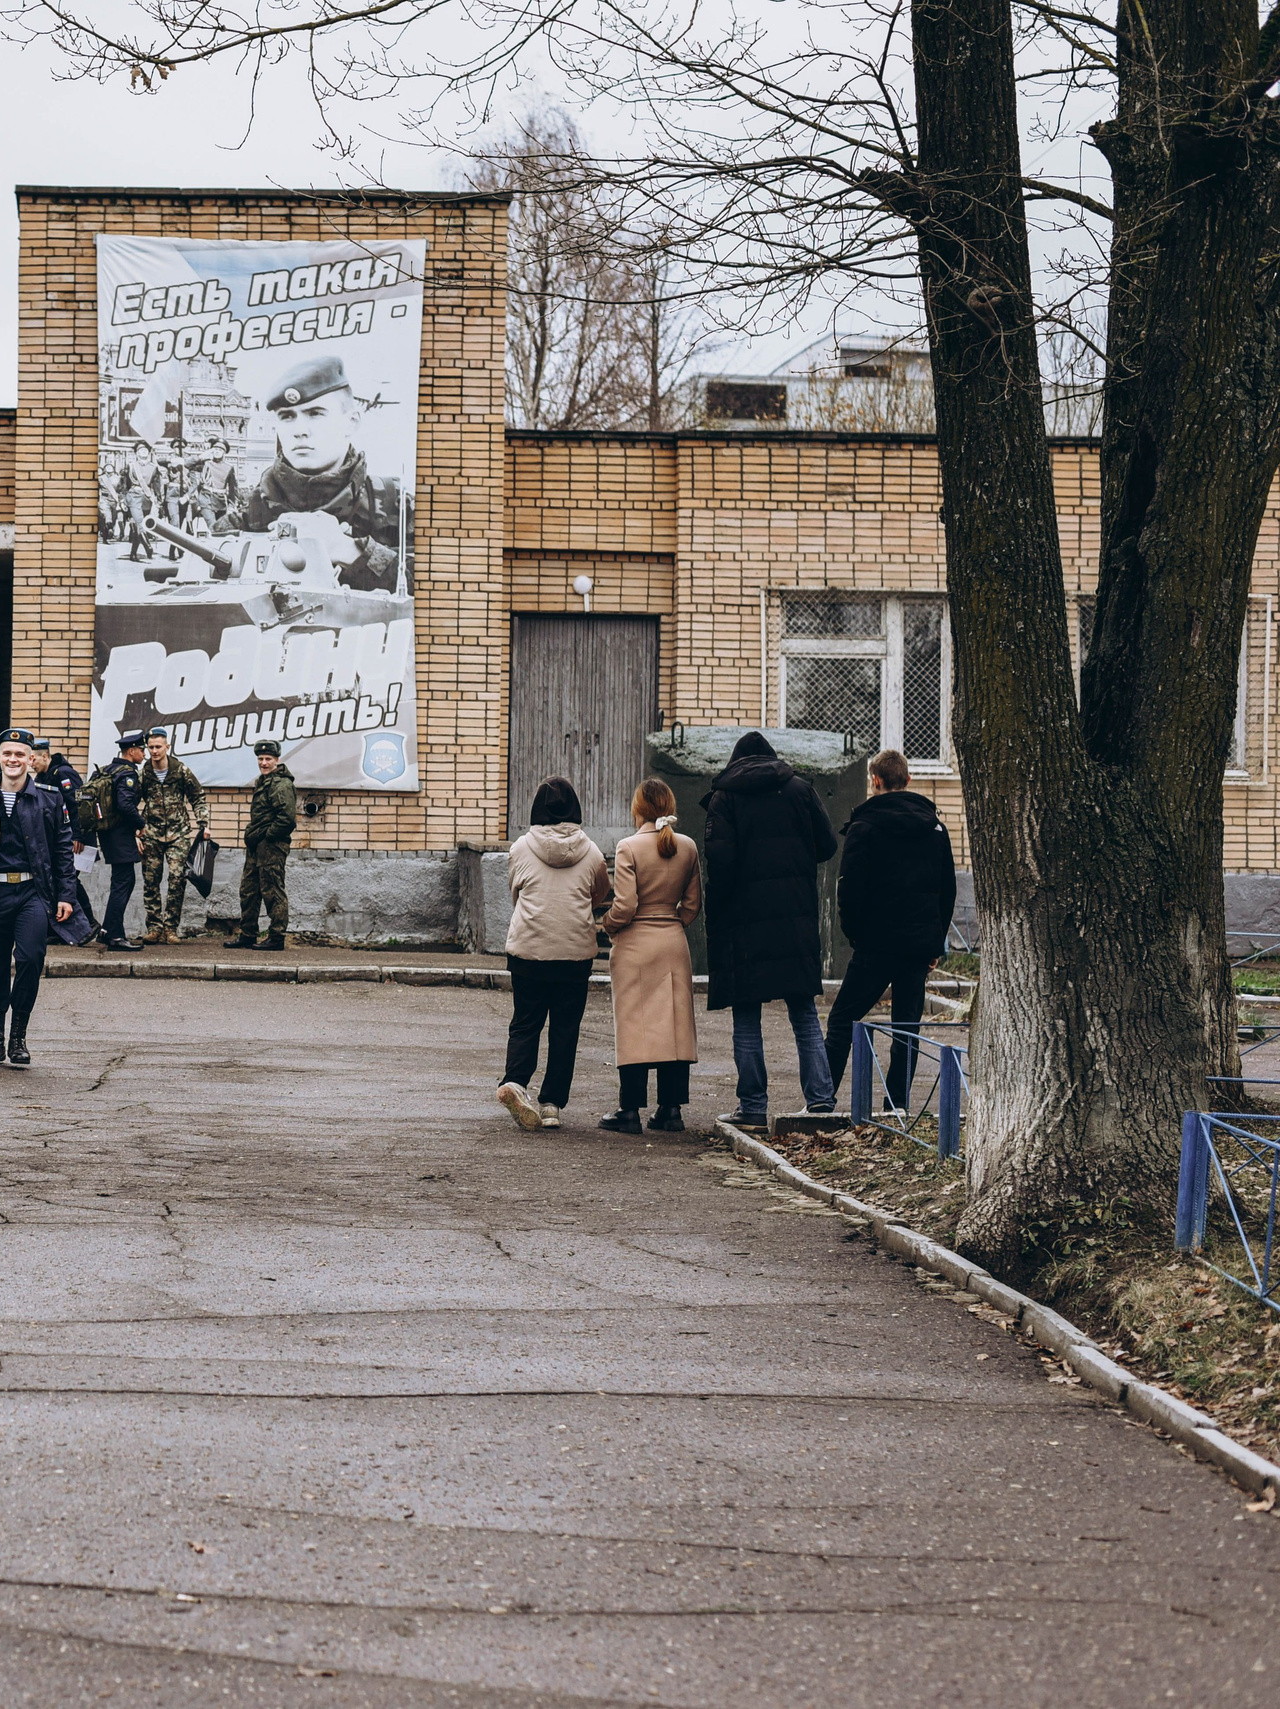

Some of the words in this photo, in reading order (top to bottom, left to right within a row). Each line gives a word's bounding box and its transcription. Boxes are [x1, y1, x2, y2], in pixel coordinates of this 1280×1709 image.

[111, 279, 231, 326] Есть
[247, 252, 402, 307] такая
[116, 299, 375, 373] профессия
[102, 618, 414, 721] Родину
